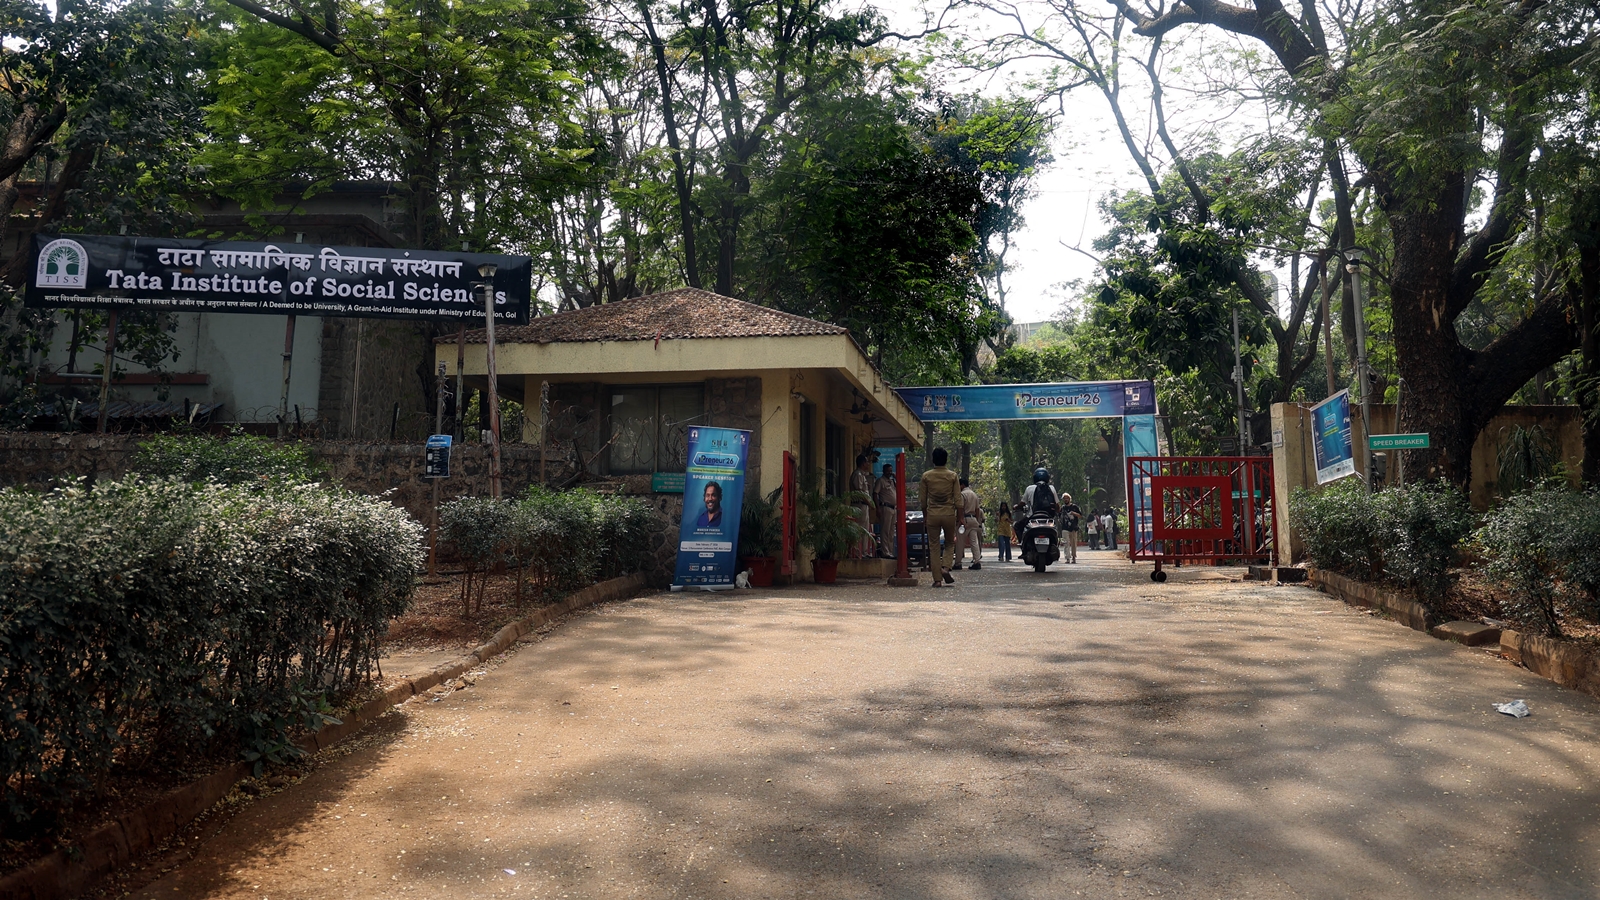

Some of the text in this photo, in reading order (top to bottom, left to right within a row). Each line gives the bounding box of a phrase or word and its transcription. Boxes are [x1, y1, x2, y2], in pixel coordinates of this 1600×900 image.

[157, 245, 463, 279] टाटा सामाजिक विज्ञान संस्थान
[45, 275, 79, 284] TISS
[105, 269, 507, 305] Tata Institute of Social Sciens
[96, 294, 112, 303] शिक्षा
[171, 297, 178, 305] के
[206, 300, 225, 308] अनुदान
[239, 299, 258, 308] संस्थान
[262, 300, 268, 308] A
[269, 300, 295, 309] Deemed
[313, 303, 347, 313] University,
[353, 304, 392, 313] Grant-in-Aid
[392, 306, 418, 314] Institute
[438, 308, 463, 318] Ministry
[464, 309, 471, 317] of
[1394, 438, 1425, 446] BREAKER
